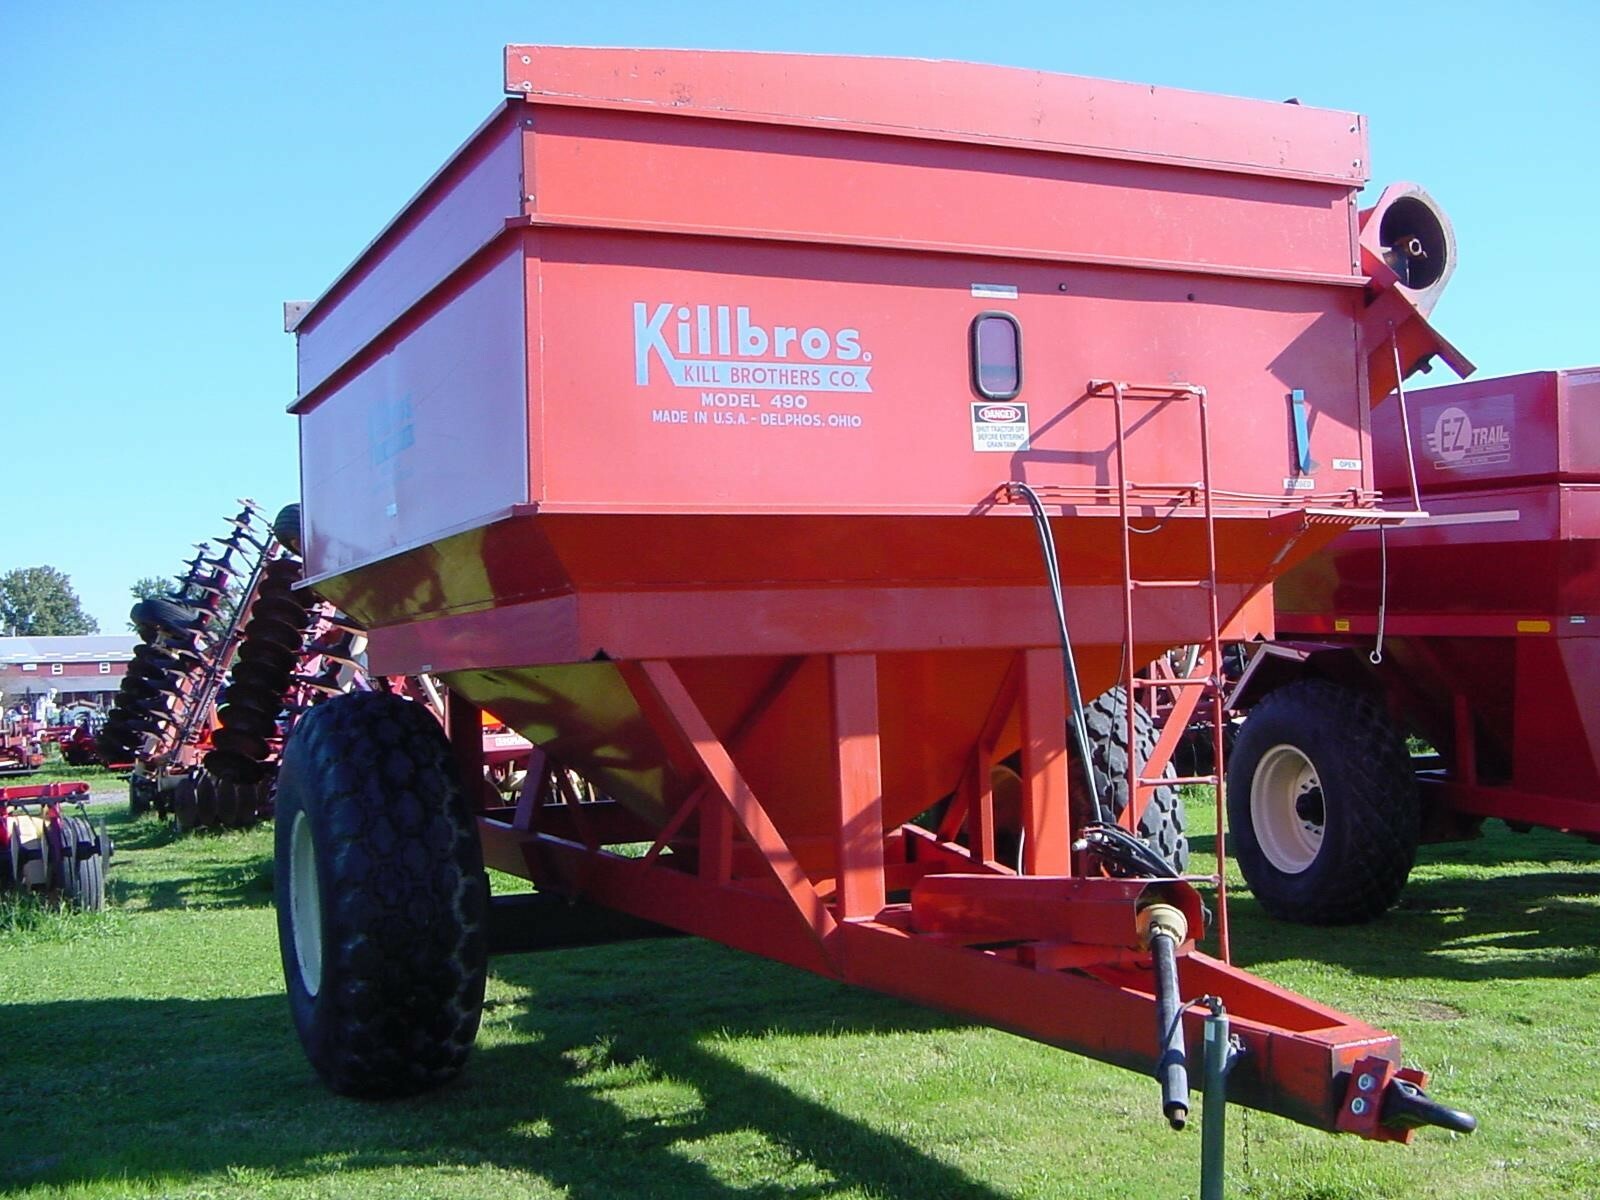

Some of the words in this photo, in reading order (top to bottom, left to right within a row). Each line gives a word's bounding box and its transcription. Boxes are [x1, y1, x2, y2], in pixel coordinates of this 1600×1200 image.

[684, 365, 721, 383] KILL
[731, 367, 821, 386] BROTHERS
[830, 370, 858, 387] CO.
[701, 392, 761, 408] MODEL
[770, 394, 808, 409] 490
[652, 410, 688, 424] MADE
[694, 411, 708, 424] IN
[828, 414, 862, 428] OHIO
[983, 409, 1016, 420] DANGER
[978, 433, 998, 441] BEFORE
[999, 433, 1025, 441] ENTERING
[991, 425, 1014, 433] TRACTOR
[1472, 424, 1510, 446] TRAIL
